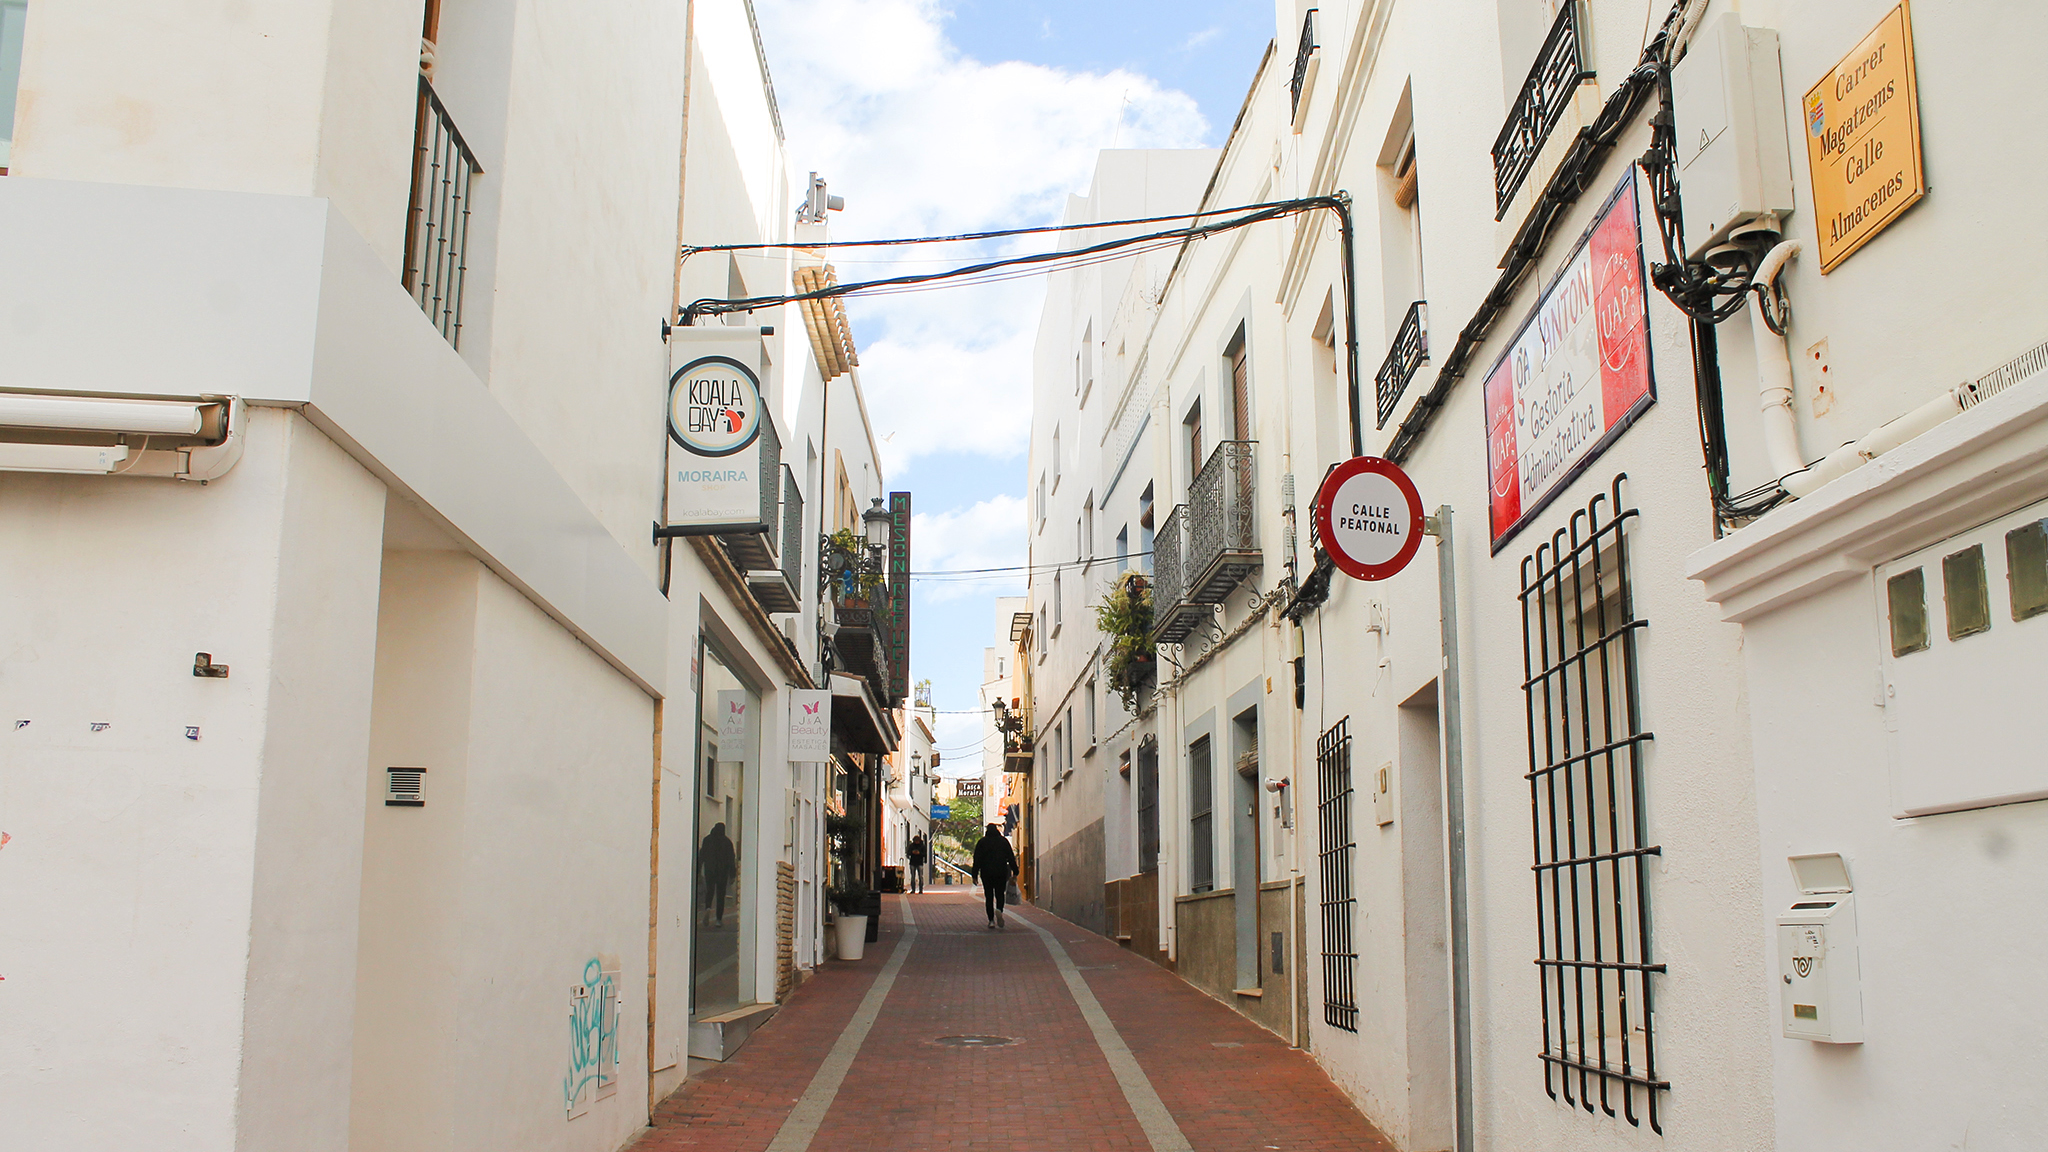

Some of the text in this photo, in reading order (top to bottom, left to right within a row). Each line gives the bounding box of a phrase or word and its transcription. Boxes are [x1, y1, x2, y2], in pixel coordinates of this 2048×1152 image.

[1835, 42, 1886, 102] Carrer
[1819, 78, 1895, 162] Magatzems
[1845, 137, 1884, 185] Calle
[1829, 170, 1903, 248] Almacenes
[1601, 284, 1629, 339] UAP
[689, 379, 743, 406] KOALA
[689, 407, 719, 432] BAY
[1492, 430, 1512, 471] UAP
[1522, 403, 1596, 501] Administrativa
[678, 470, 748, 482] MORAIRA
[682, 508, 745, 517] koalabay.com
[1340, 517, 1400, 535] PEATONAL
[1352, 503, 1390, 519] CALLE
[893, 497, 906, 573] MESON
[791, 725, 828, 735] Beauty
[813, 716, 822, 725] A
